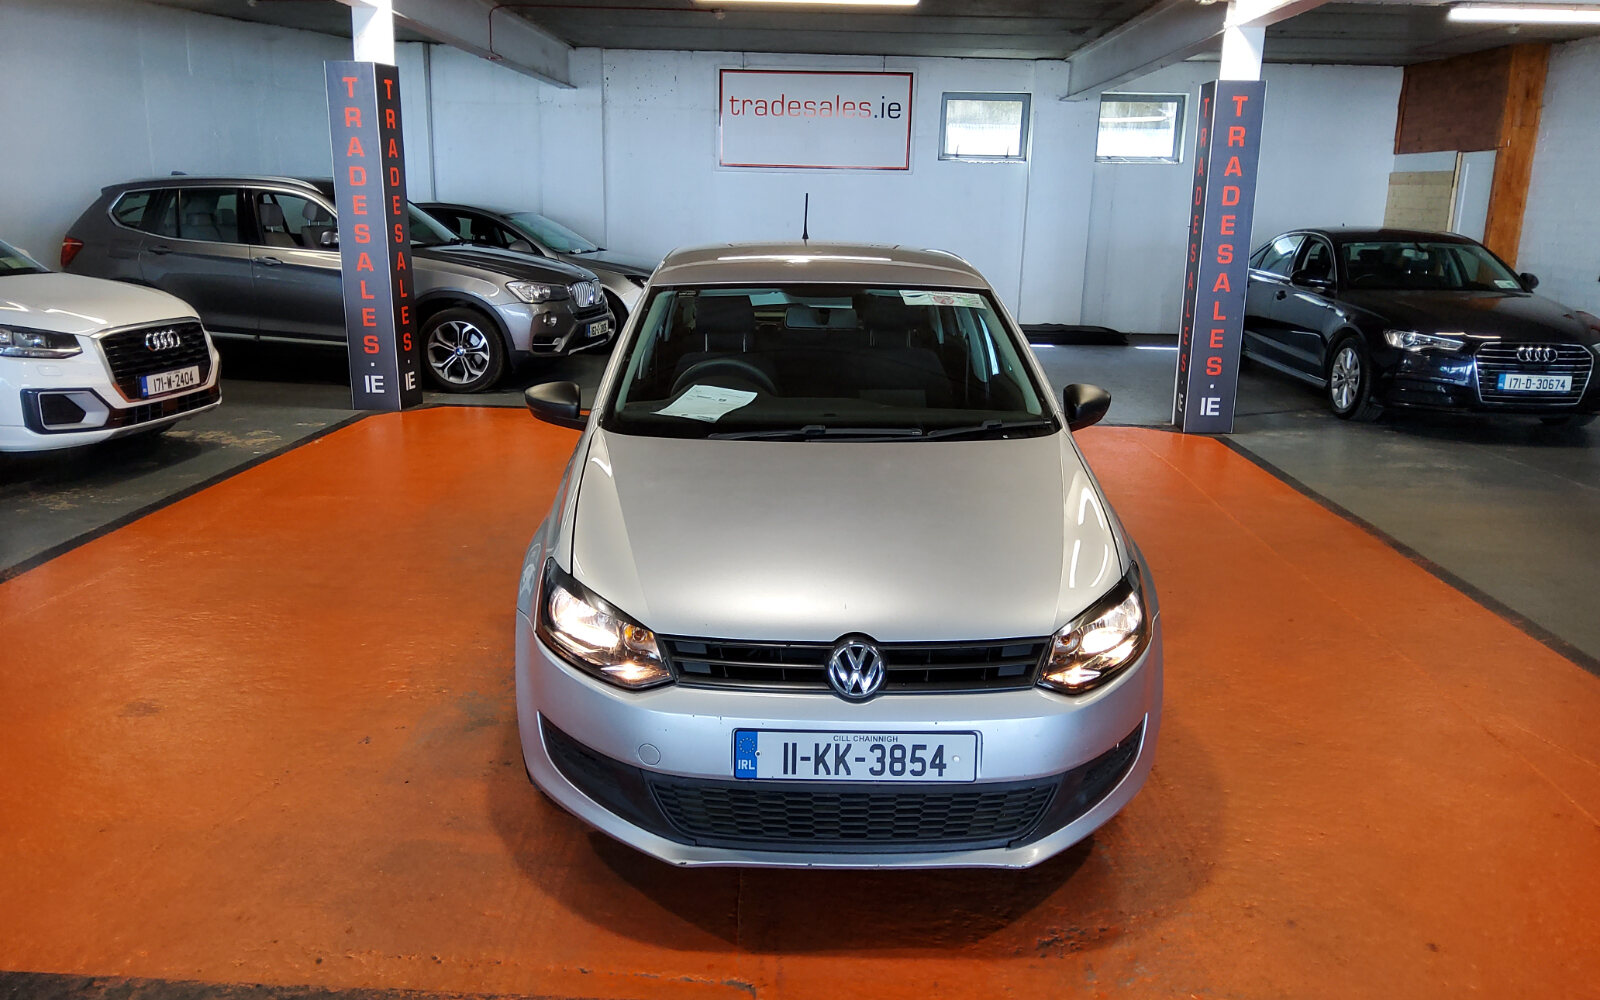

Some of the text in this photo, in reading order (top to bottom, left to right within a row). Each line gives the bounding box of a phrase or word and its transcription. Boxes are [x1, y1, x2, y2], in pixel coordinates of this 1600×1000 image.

[729, 93, 901, 119] tradesales.ie
[153, 370, 194, 392] 171-W-2404
[1509, 377, 1566, 390] 171-D-30674
[853, 735, 899, 743] CHAINNIGH
[737, 759, 756, 770] IRL
[782, 742, 947, 777] 11-KK-3854
